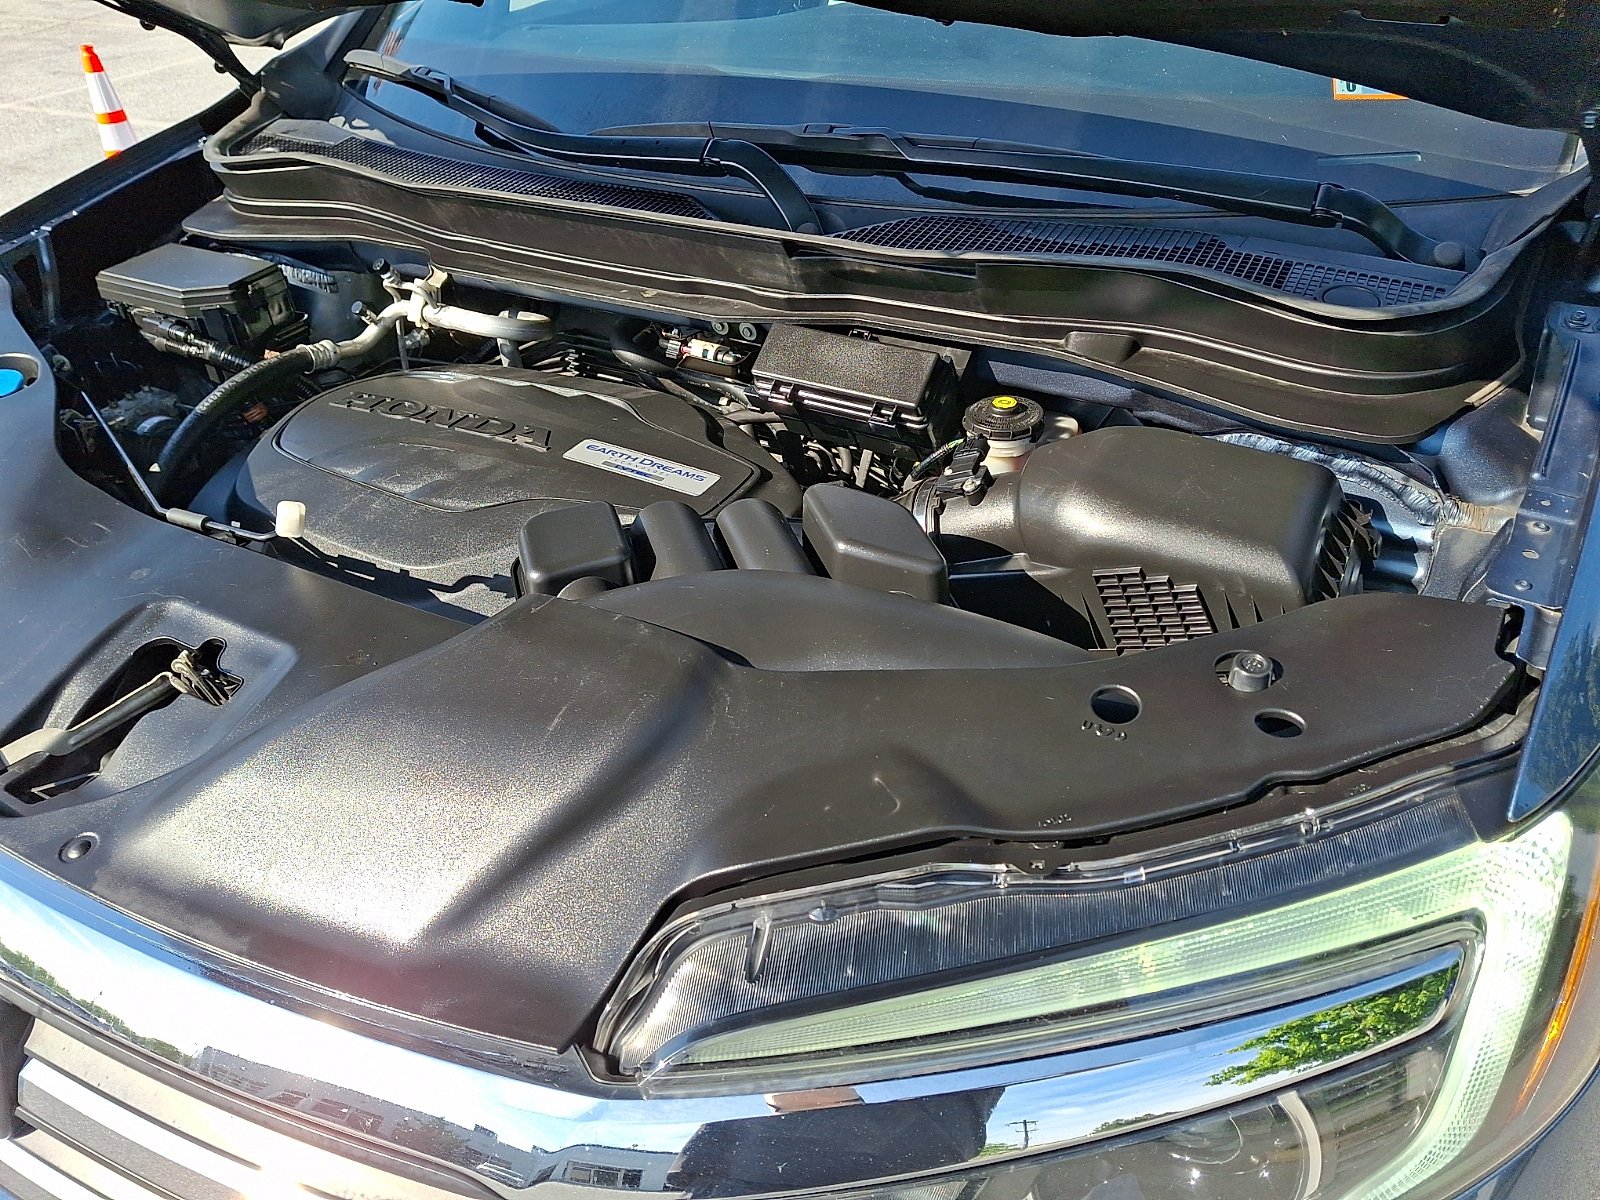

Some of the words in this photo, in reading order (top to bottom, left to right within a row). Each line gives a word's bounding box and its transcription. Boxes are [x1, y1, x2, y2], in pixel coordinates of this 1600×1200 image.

[329, 391, 552, 453] HONDA
[585, 443, 638, 462] EARTH
[639, 457, 708, 482] DREAMS
